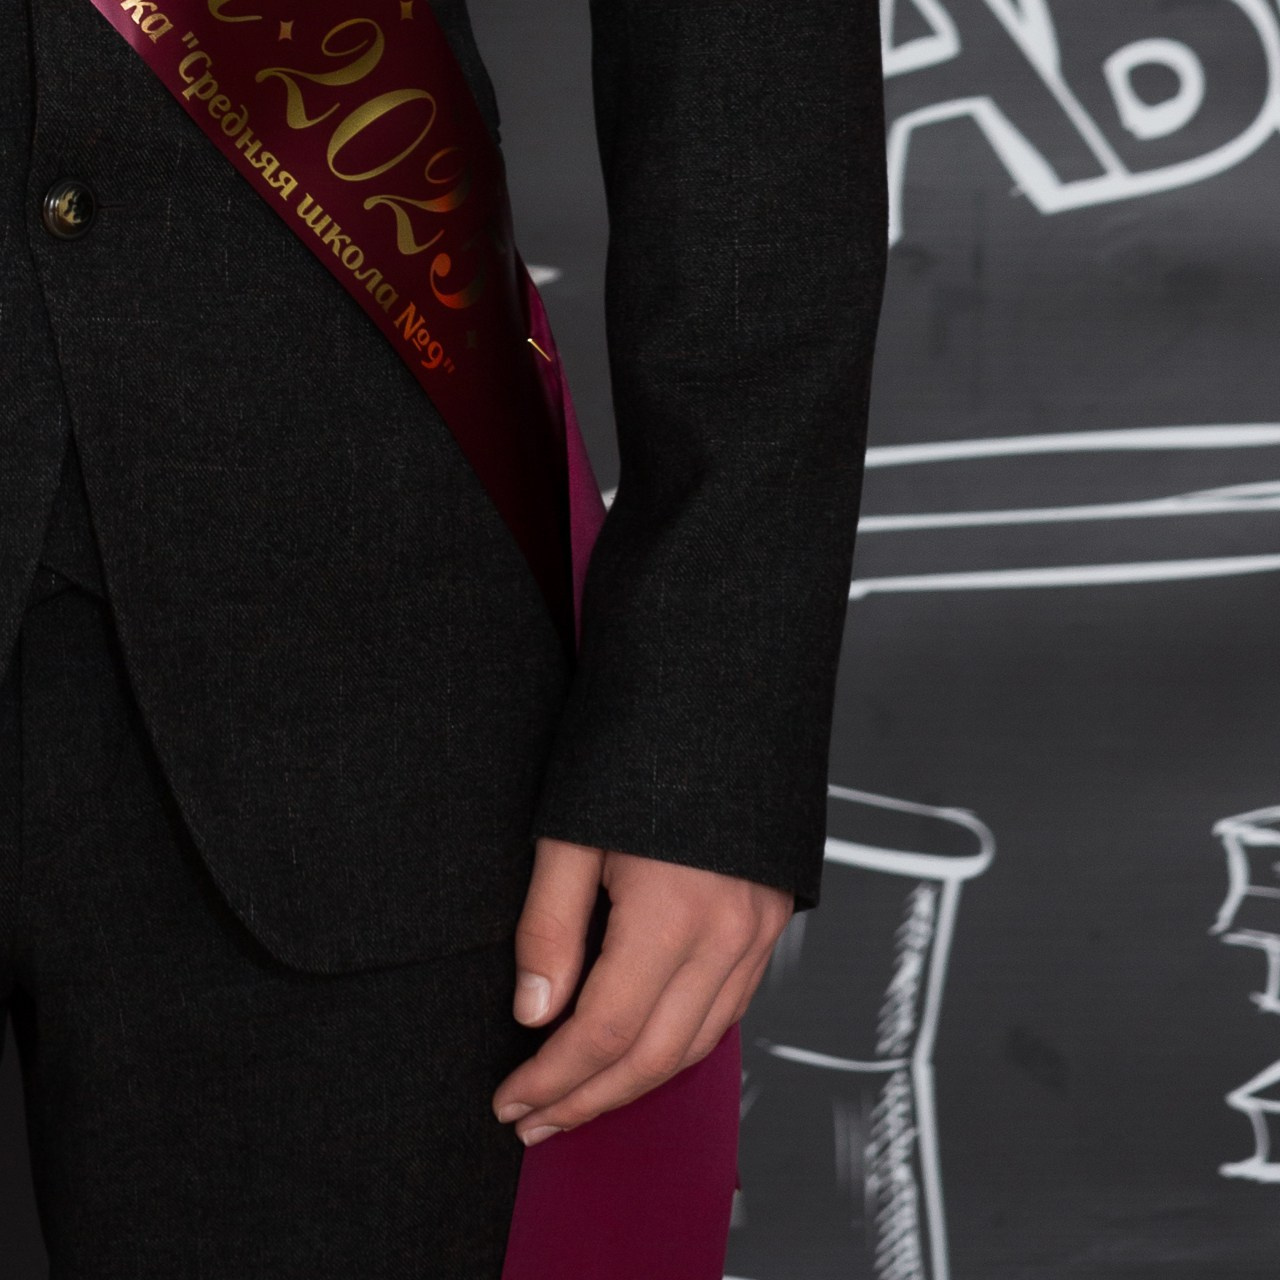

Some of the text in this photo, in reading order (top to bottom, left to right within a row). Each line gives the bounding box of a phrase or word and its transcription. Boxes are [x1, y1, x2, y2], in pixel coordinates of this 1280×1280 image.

[178, 30, 299, 201] "Средняя
[296, 192, 400, 314] школа
[393, 301, 456, 375] №9"
